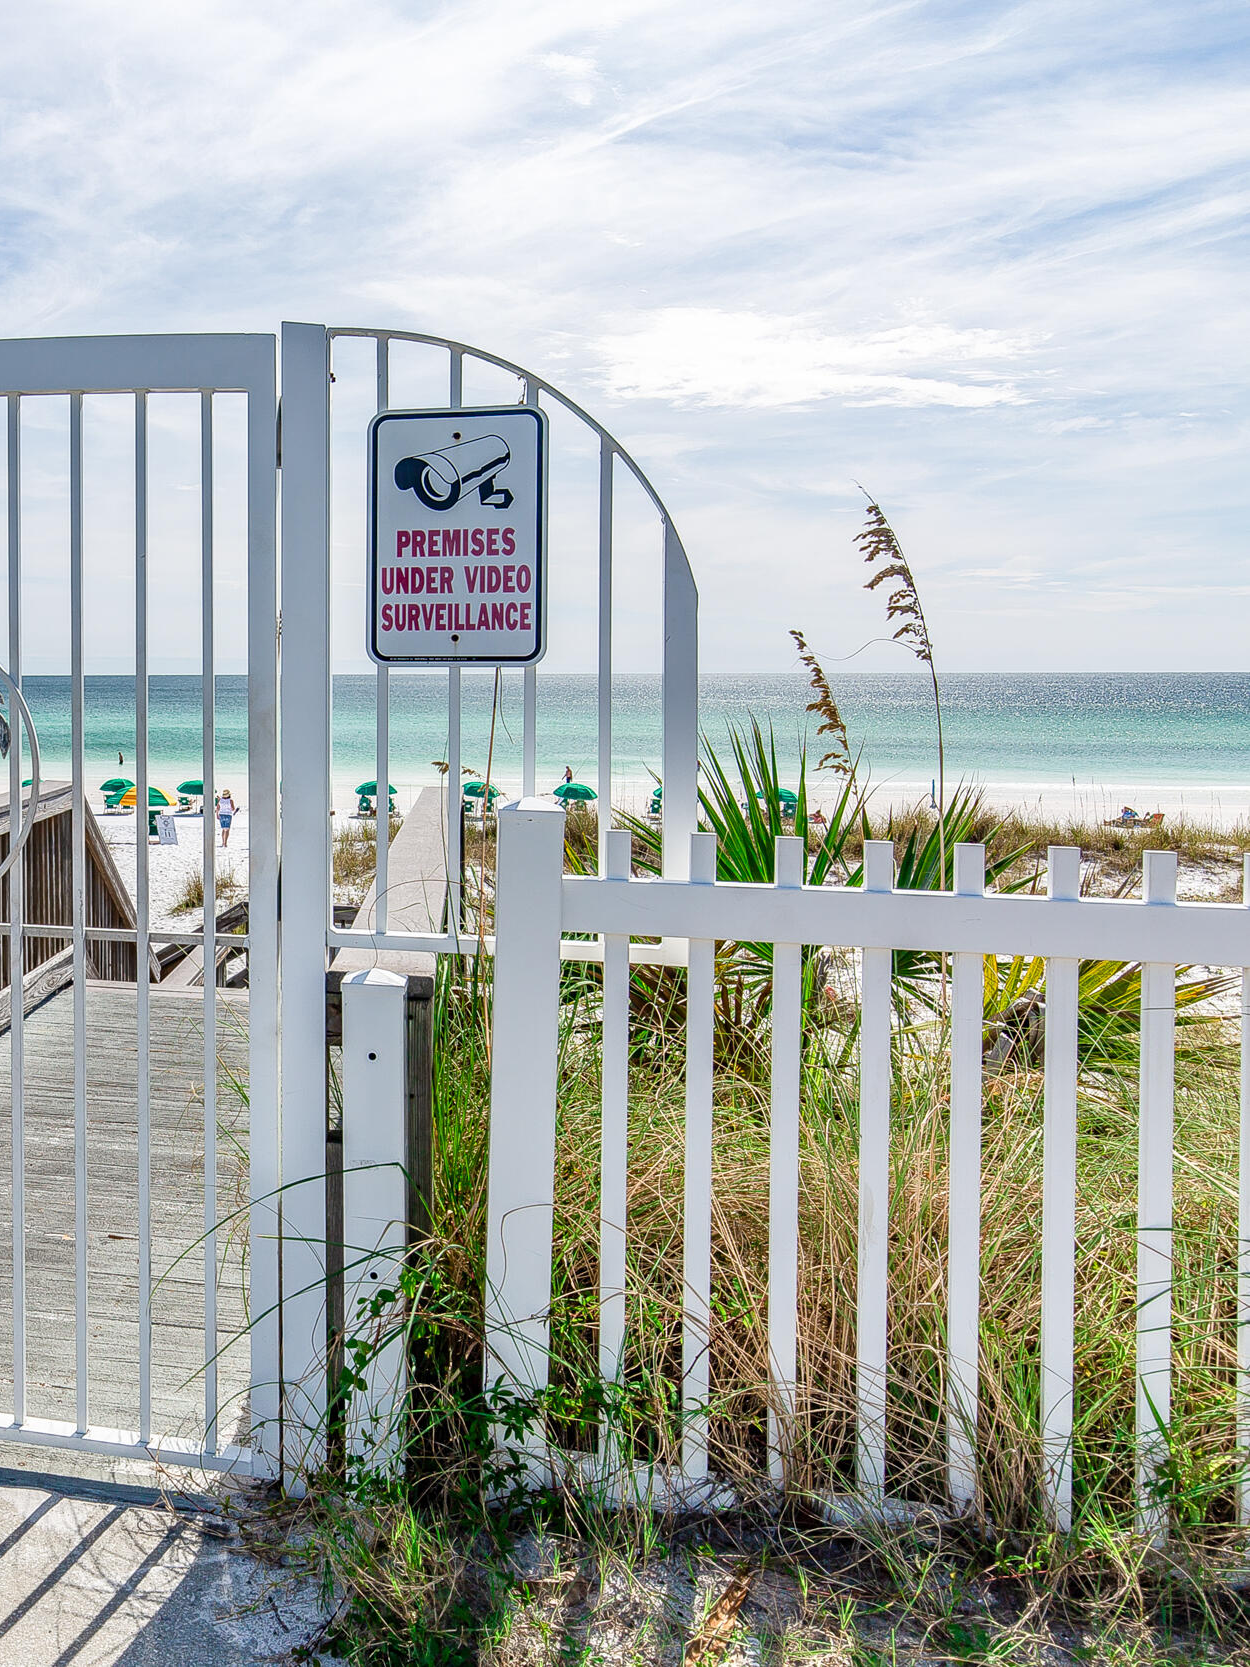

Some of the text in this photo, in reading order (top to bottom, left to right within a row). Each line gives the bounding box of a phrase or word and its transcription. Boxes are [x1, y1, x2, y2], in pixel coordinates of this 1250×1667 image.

[396, 528, 516, 558] PREMISES
[381, 565, 532, 594] UNDER VIDEO
[381, 602, 532, 632] SURVEILLANCE
